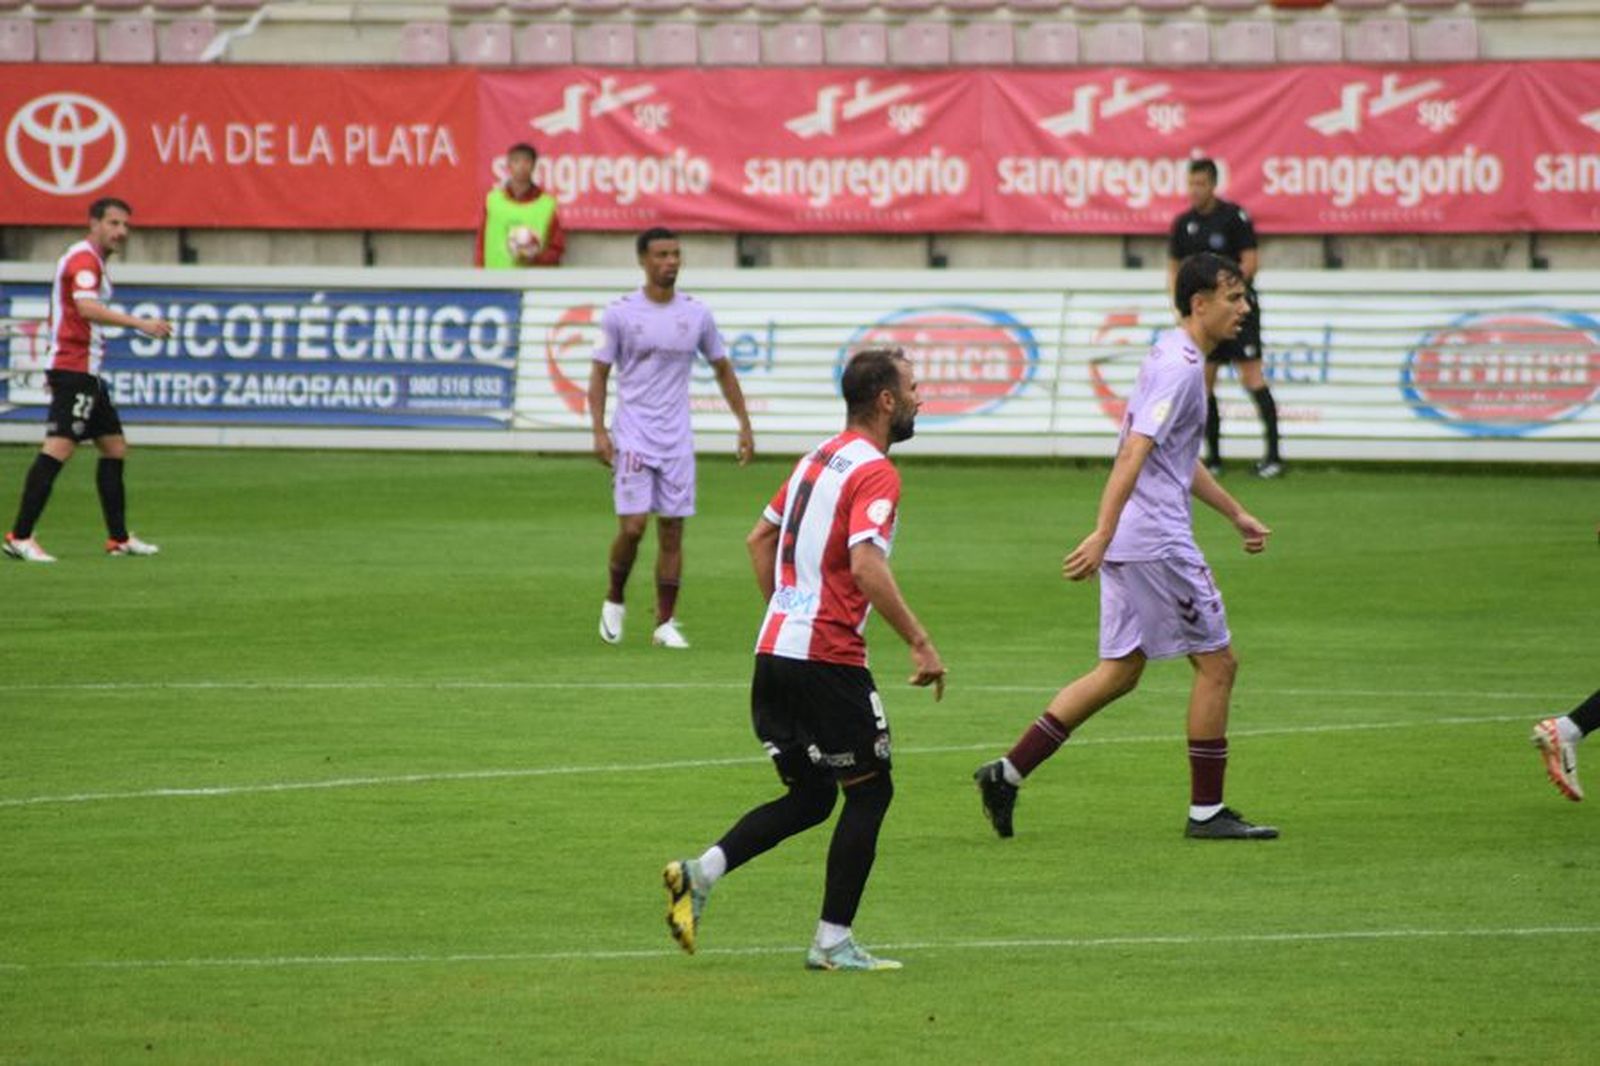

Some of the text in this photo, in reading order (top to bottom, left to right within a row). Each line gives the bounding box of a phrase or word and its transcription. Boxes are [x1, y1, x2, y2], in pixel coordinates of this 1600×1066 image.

[151, 115, 458, 167] VÍA DE LA PLATA
[491, 147, 712, 204] sngregorio
[744, 147, 968, 208] sangregorio
[1262, 145, 1502, 209] sangregorio
[223, 373, 398, 408] ZAMORANO
[868, 691, 888, 731] 9
